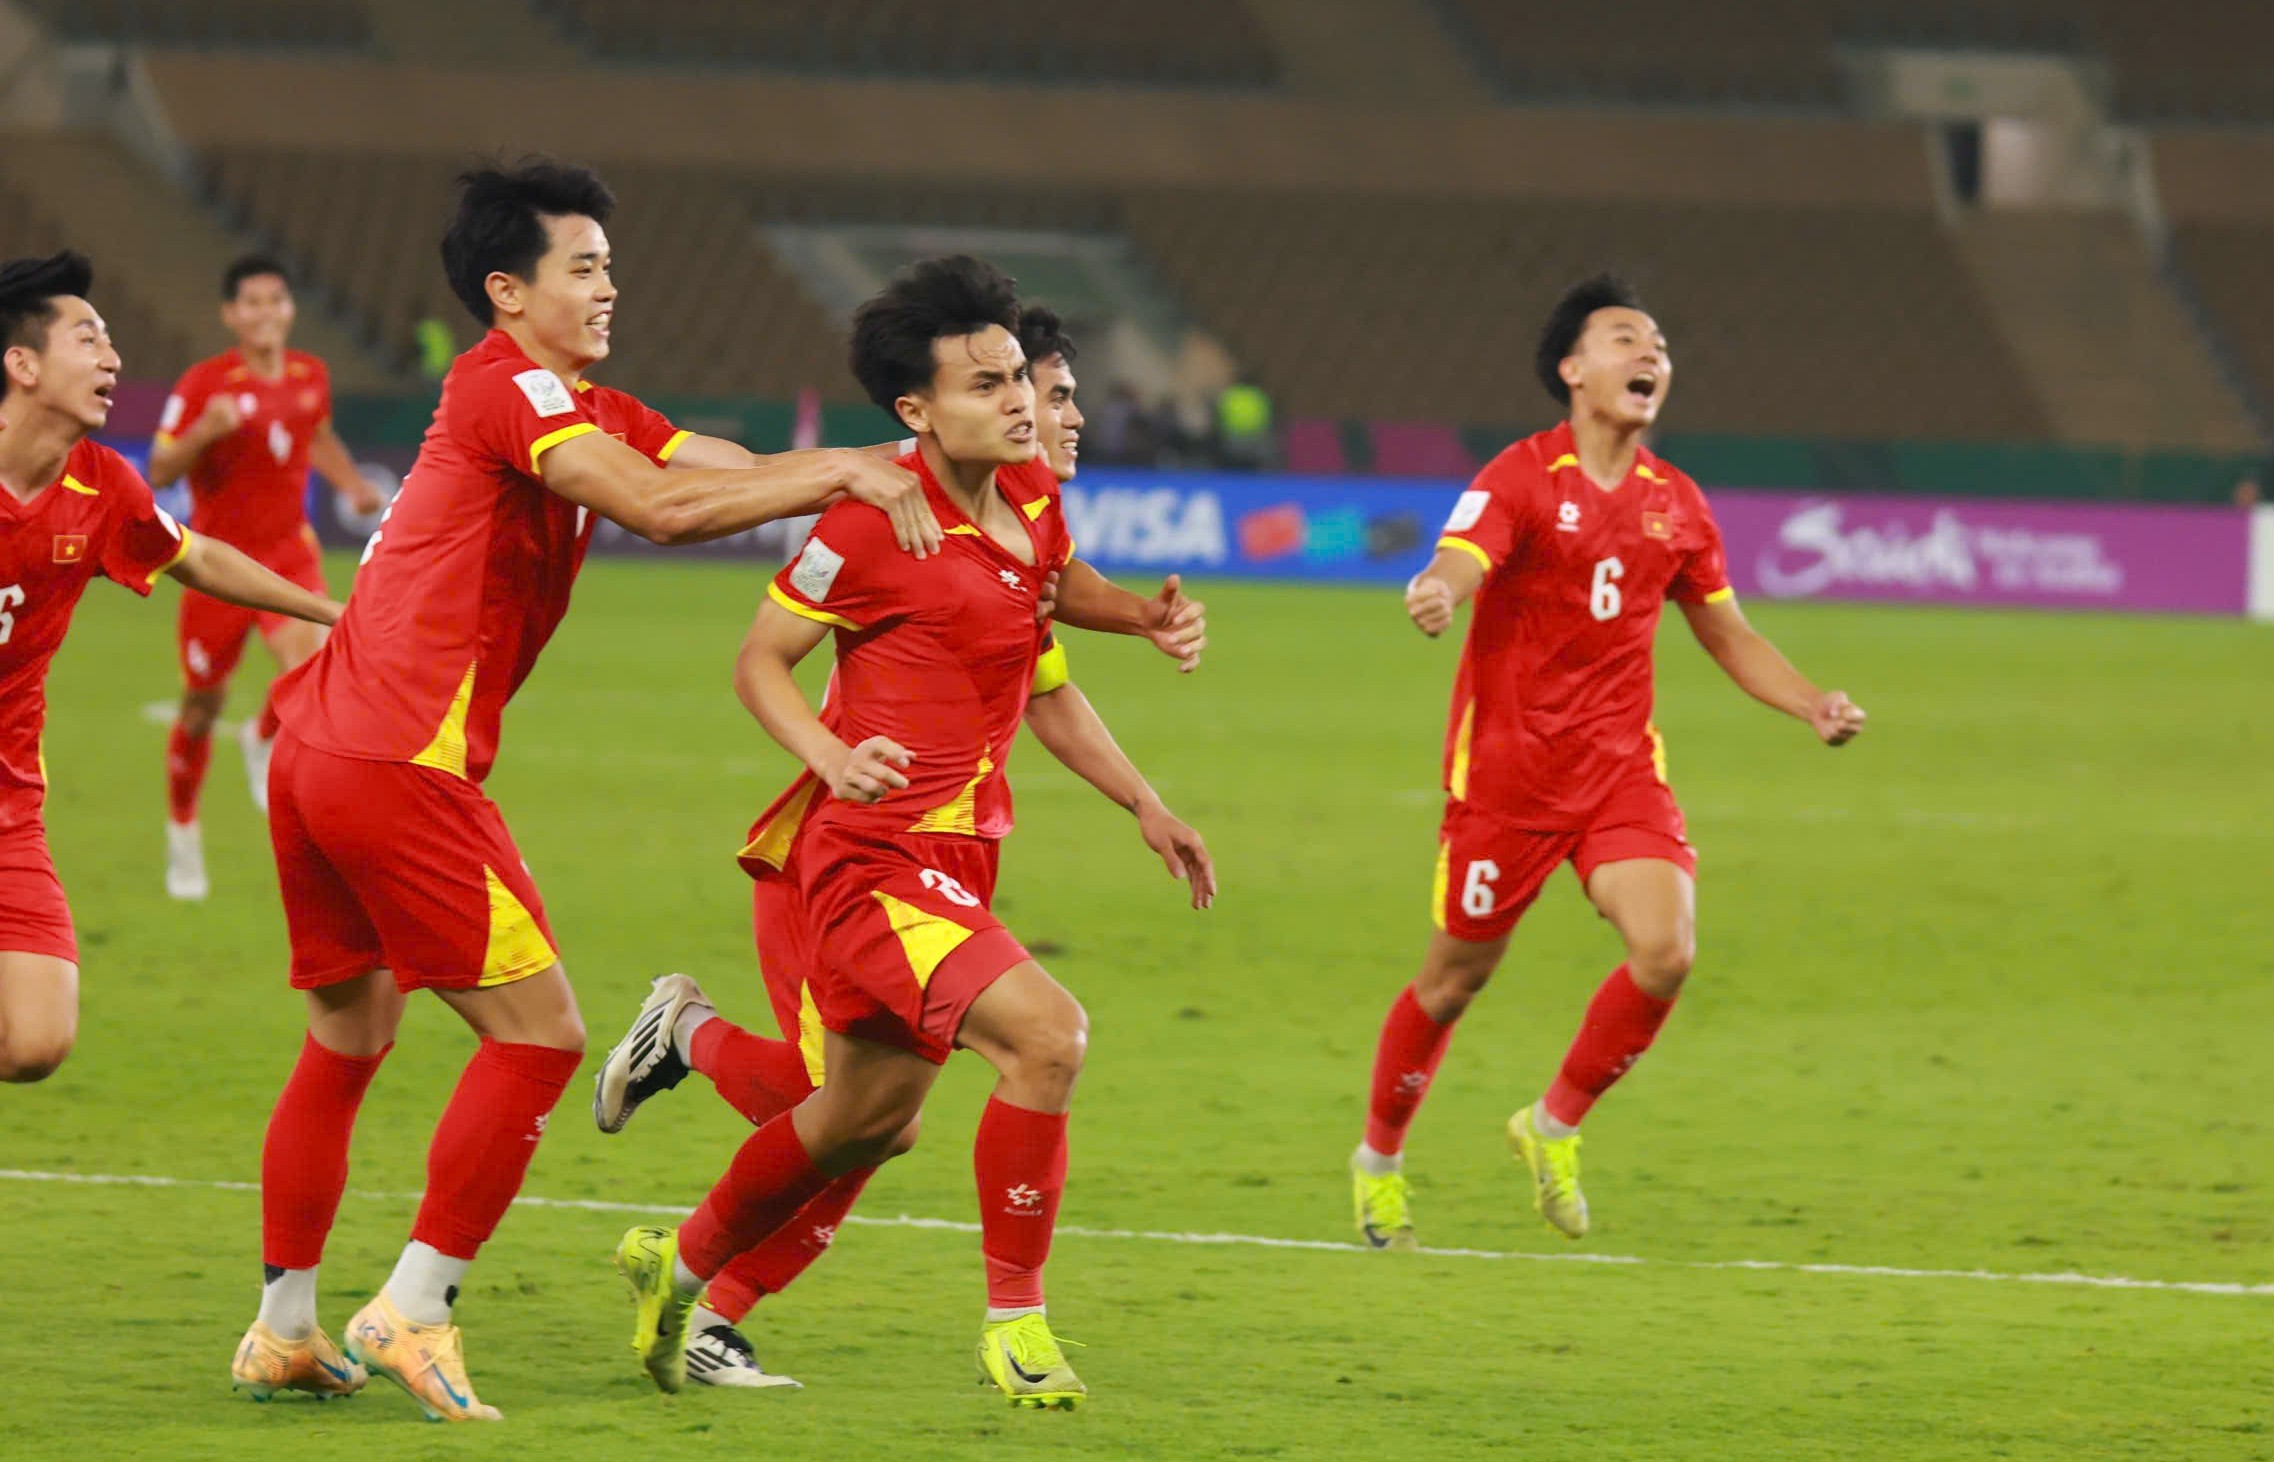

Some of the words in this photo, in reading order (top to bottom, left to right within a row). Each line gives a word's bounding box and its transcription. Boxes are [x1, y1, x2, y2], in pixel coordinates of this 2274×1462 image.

[1062, 486, 1228, 562] VISA
[1590, 556, 1625, 621] 6
[1461, 859, 1501, 918] 6
